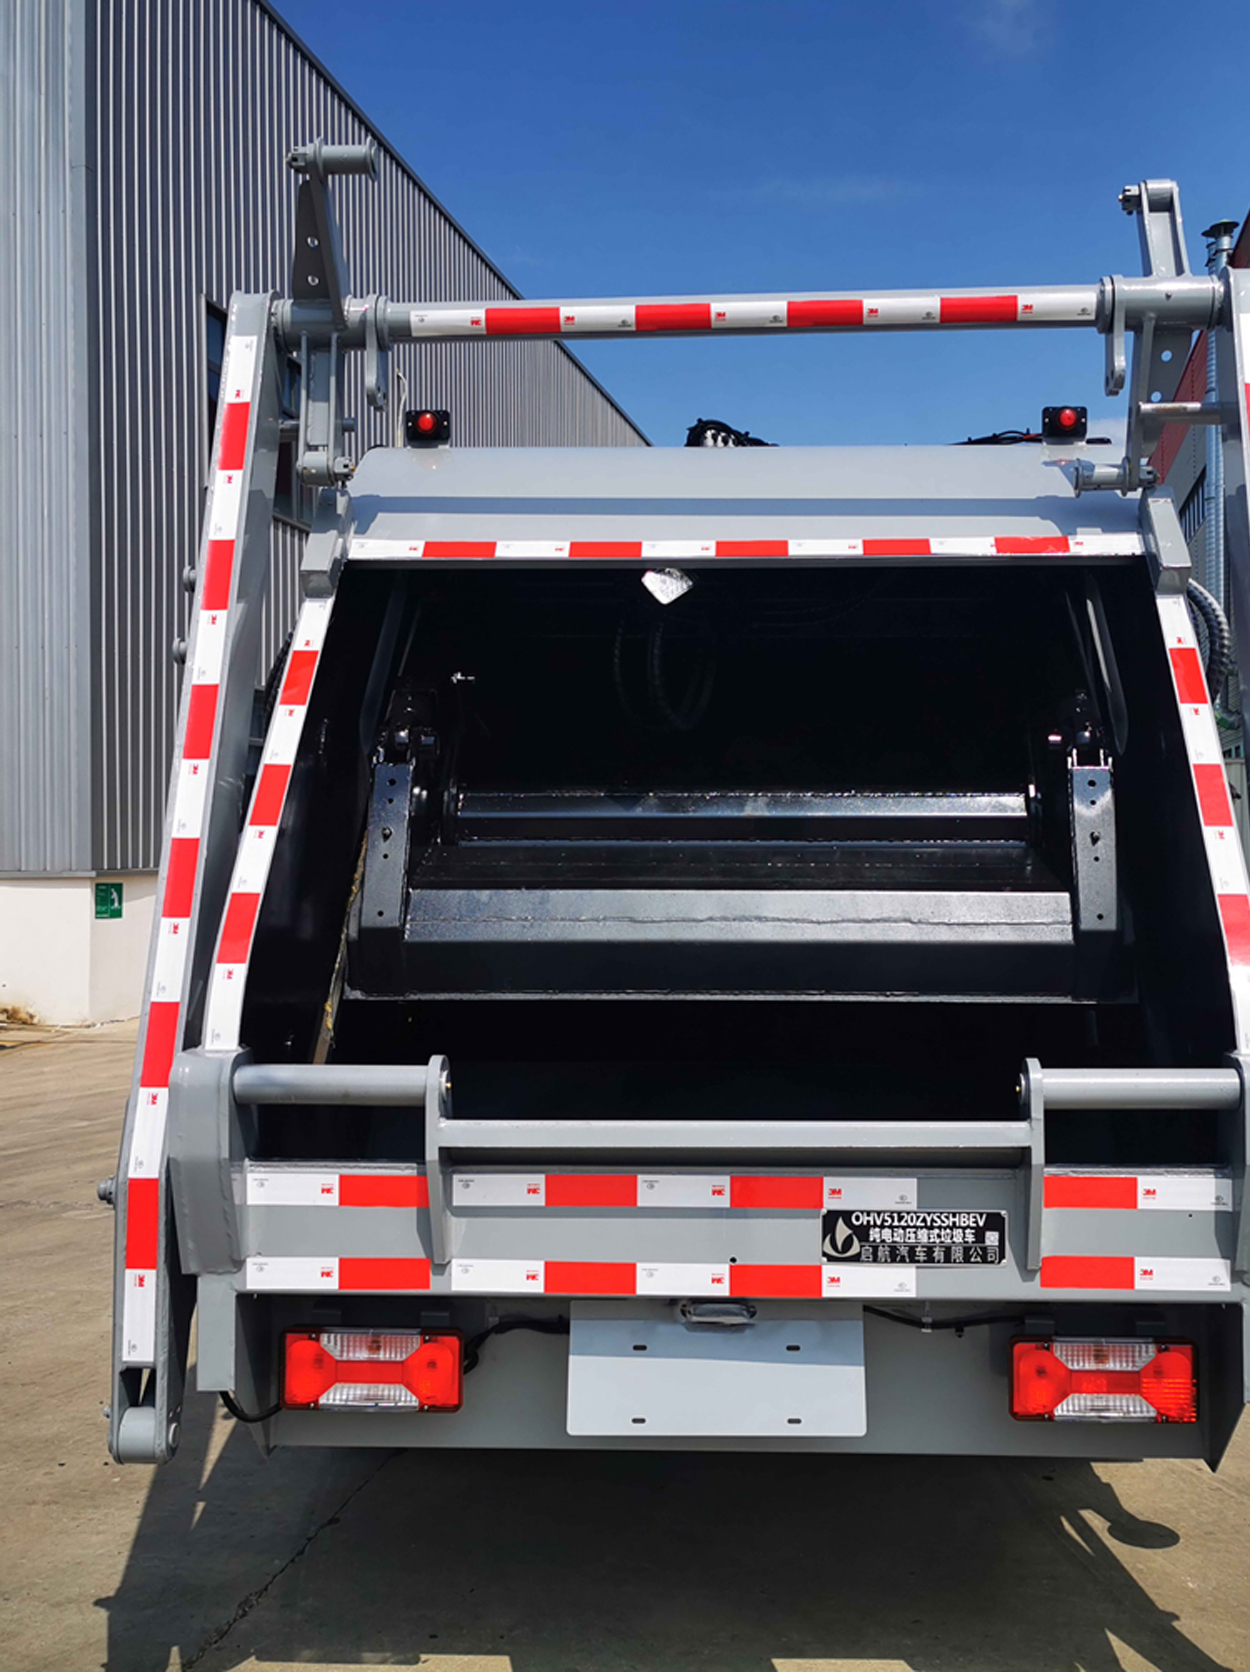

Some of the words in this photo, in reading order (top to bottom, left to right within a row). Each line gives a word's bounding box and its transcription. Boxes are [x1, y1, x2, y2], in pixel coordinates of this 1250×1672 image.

[869, 1227, 976, 1243] 纯电动压缩式垃圾车
[860, 1245, 999, 1263] 启航汽车有限公司
